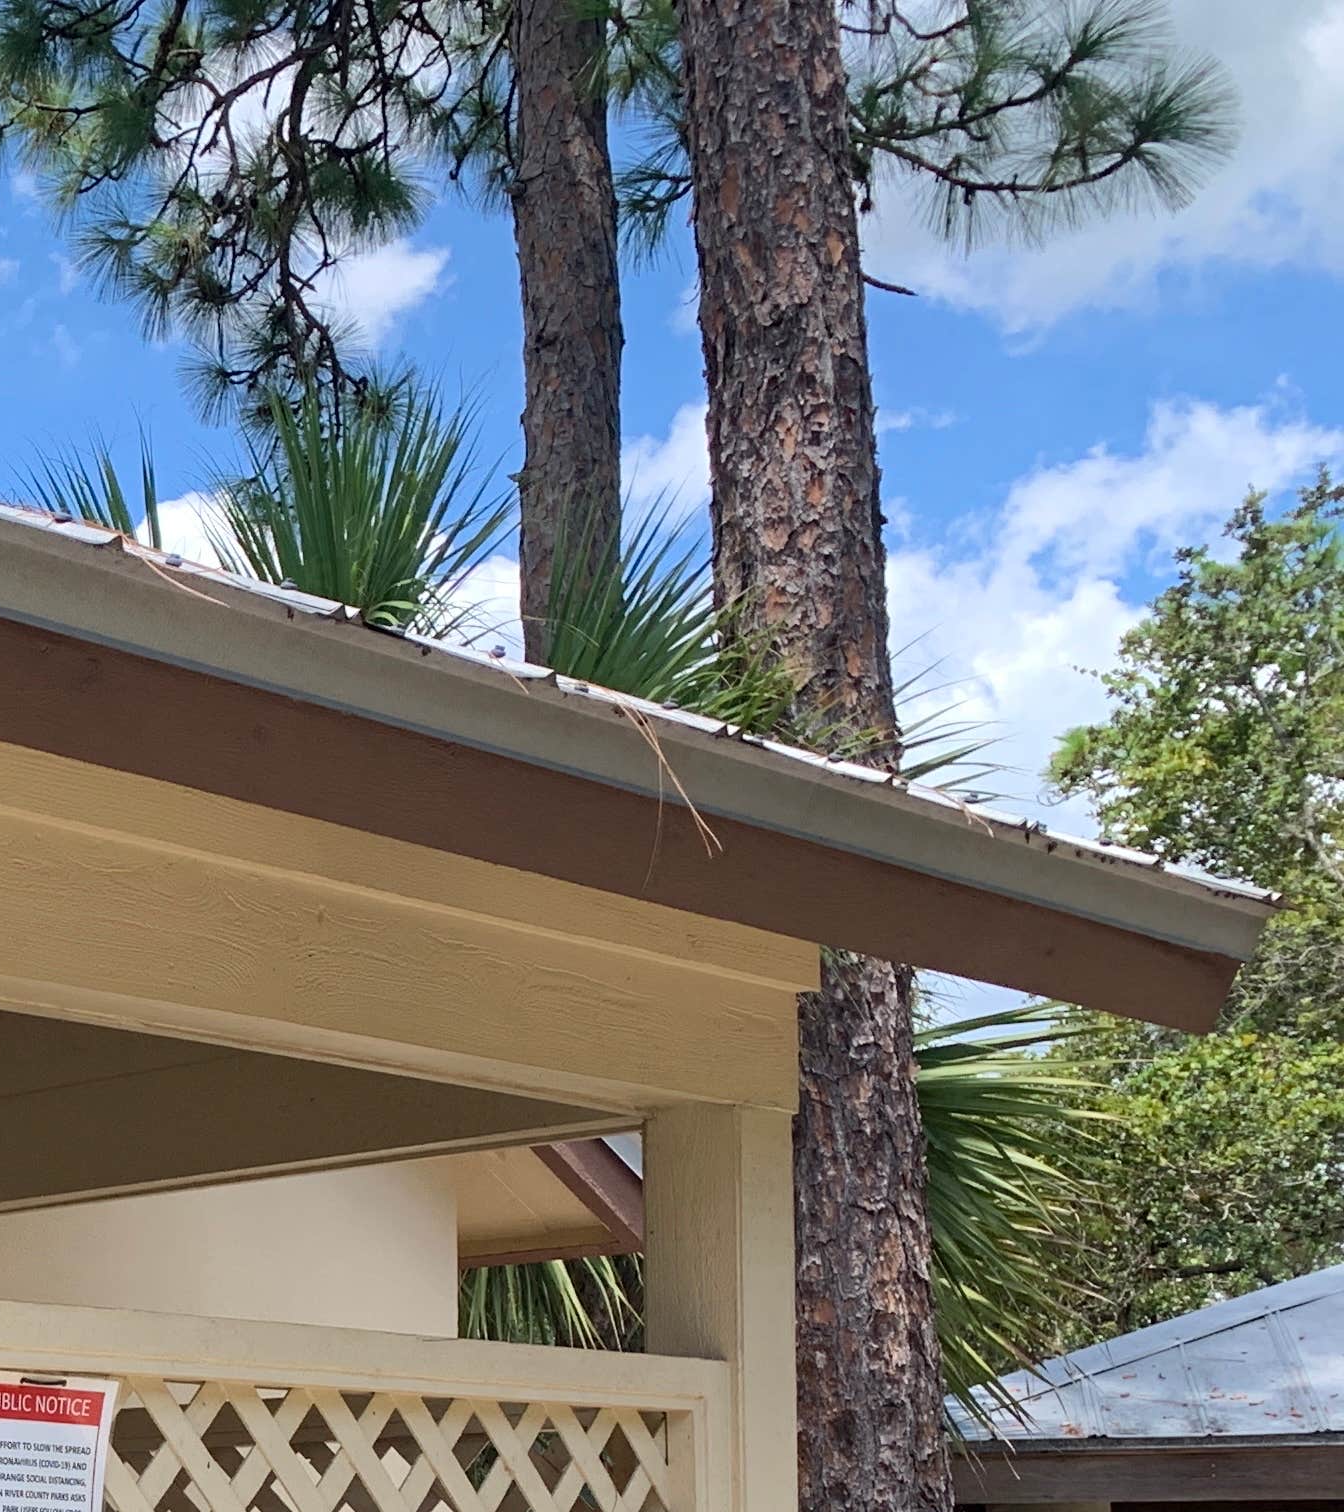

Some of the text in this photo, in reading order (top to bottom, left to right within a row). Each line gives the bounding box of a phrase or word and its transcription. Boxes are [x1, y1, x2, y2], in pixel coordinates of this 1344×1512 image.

[35, 1395, 92, 1416] NOTICE
[22, 1442, 32, 1451] TO
[33, 1443, 50, 1453] SLOW
[52, 1444, 63, 1454] THE
[64, 1445, 91, 1456] SPREAD
[72, 1461, 87, 1471] AND
[26, 1474, 47, 1485] SOCIAL
[4, 1488, 24, 1499] RIVER
[25, 1490, 49, 1501] COUNTY
[50, 1492, 69, 1502] PARKS
[70, 1493, 86, 1503] ASKS
